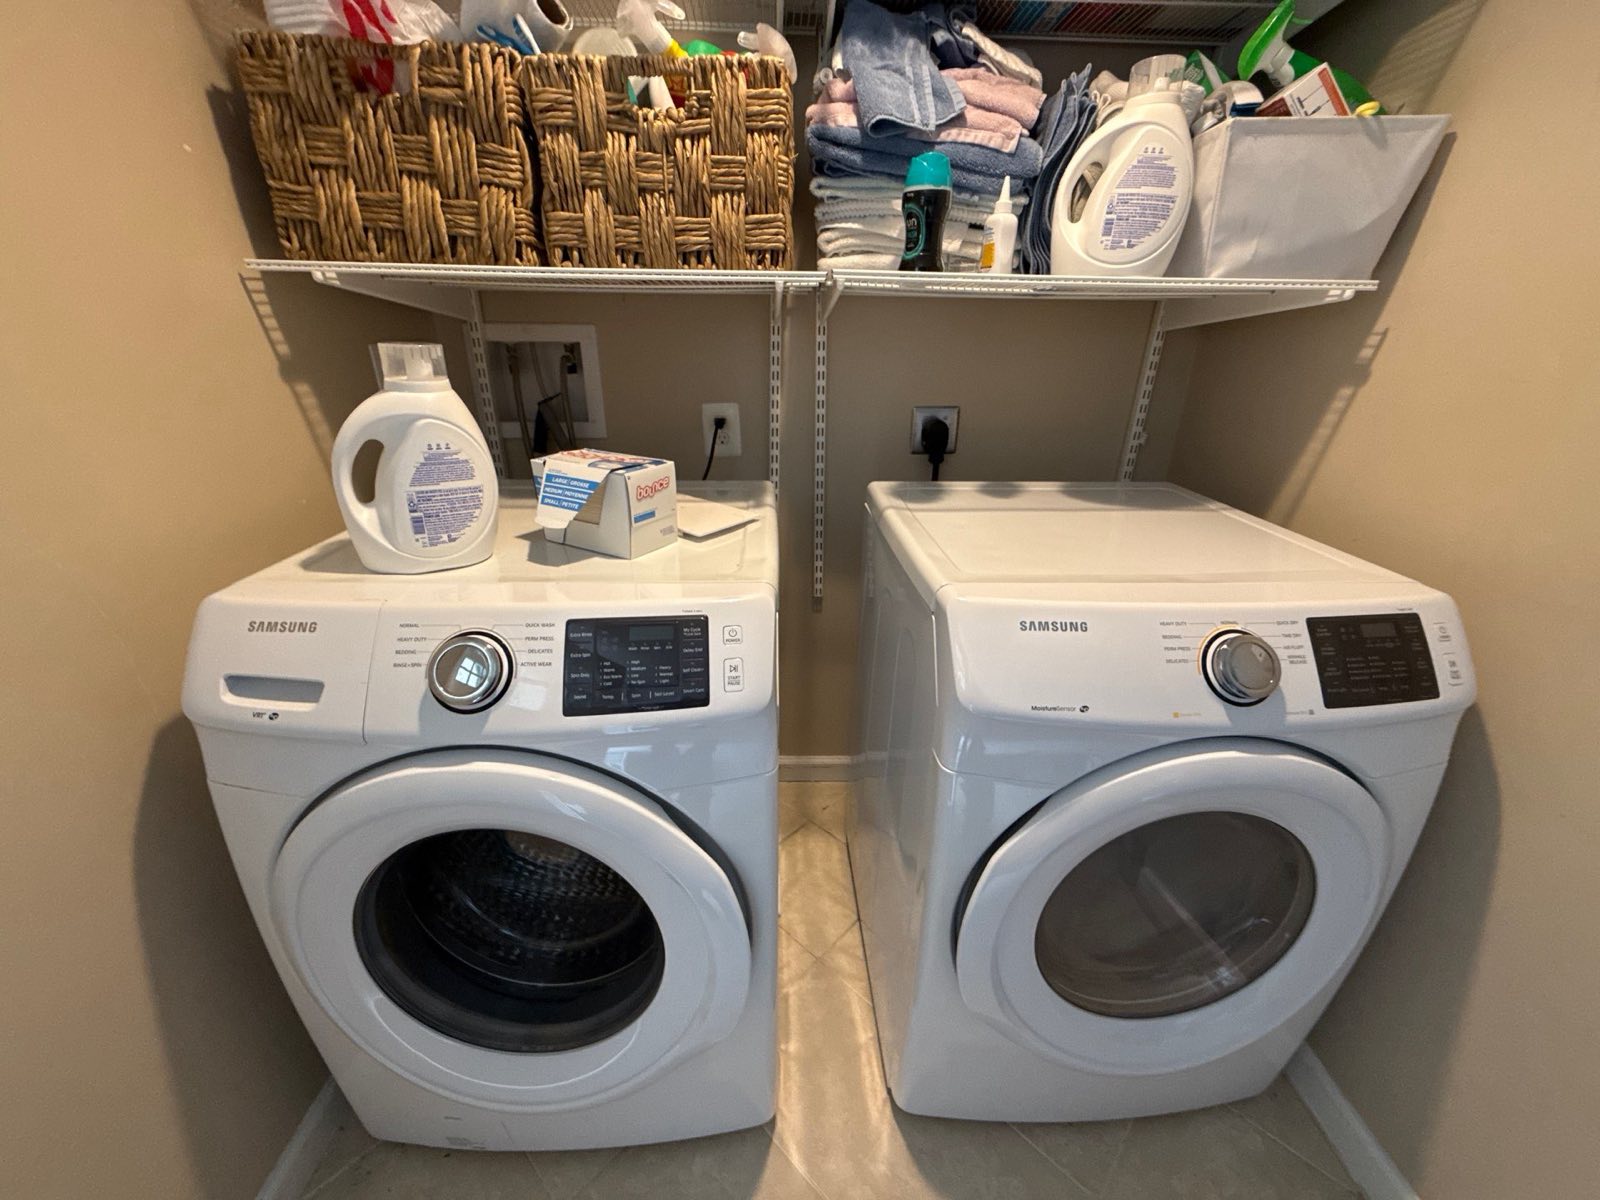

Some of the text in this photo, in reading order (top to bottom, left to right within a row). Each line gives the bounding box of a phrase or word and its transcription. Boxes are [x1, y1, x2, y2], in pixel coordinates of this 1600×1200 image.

[570, 480, 590, 489] GROSSE
[636, 476, 670, 501] bounce
[565, 490, 589, 500] MOYENNE
[544, 497, 580, 510] SMALL PETITE
[248, 620, 318, 633] SAMSUNG
[1019, 620, 1088, 632] SAMSUNG
